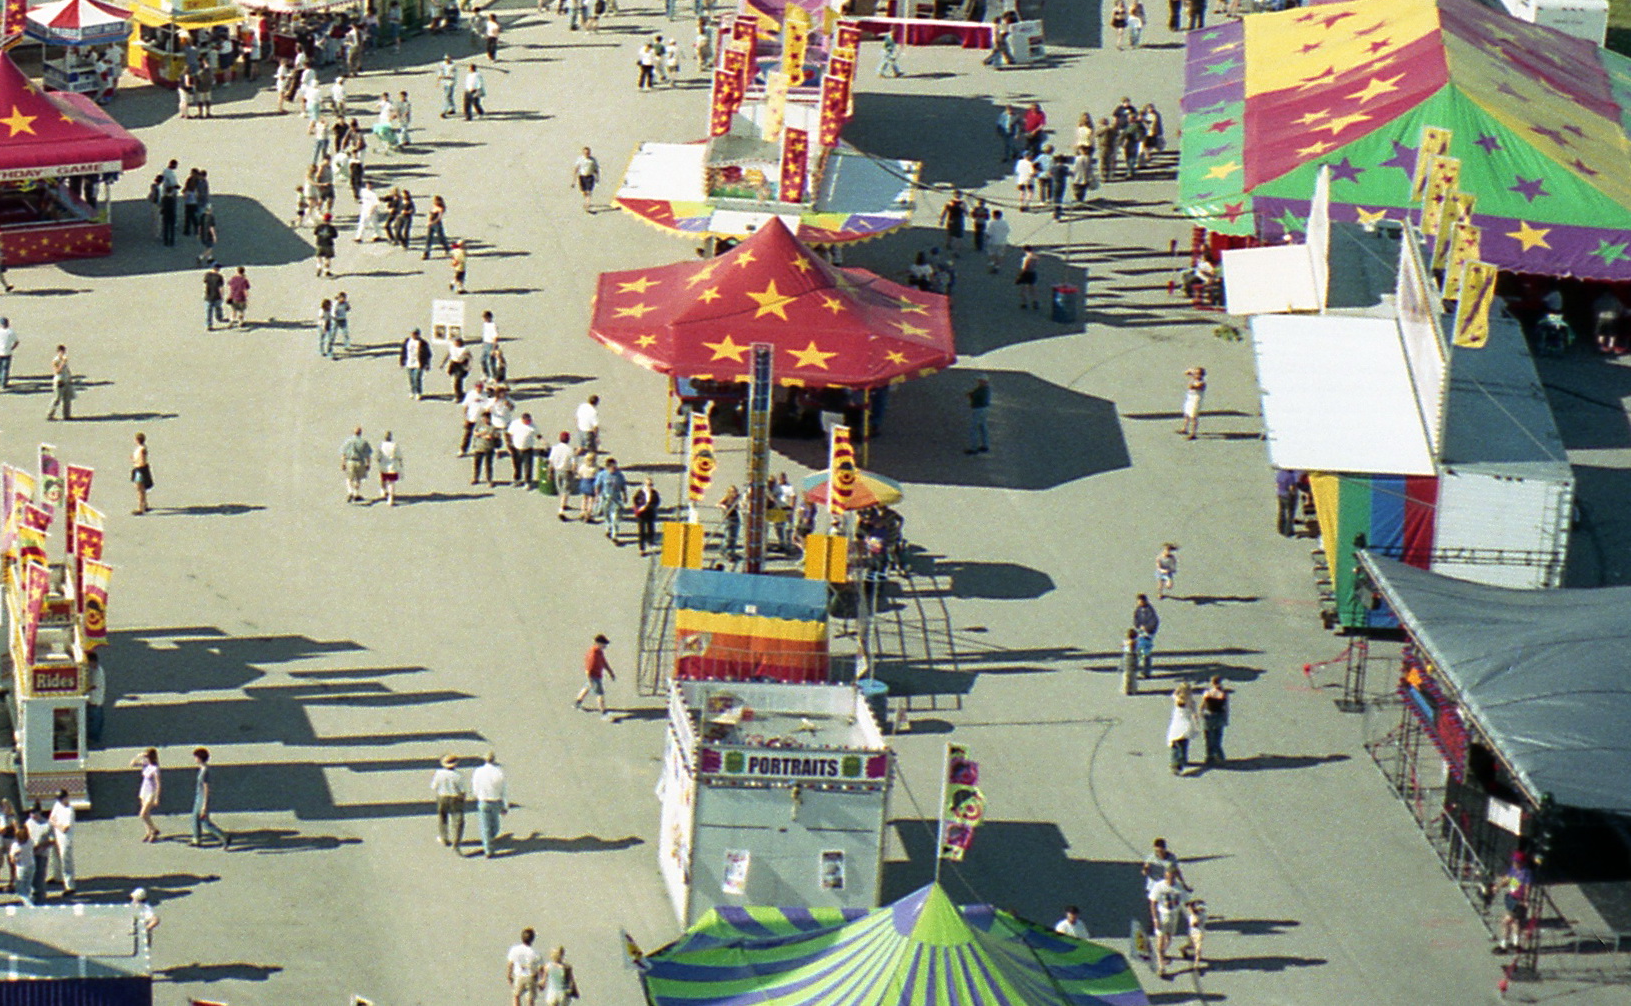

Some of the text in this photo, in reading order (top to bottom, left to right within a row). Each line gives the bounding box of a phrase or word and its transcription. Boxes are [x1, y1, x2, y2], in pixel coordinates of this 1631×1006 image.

[57, 163, 104, 174] GAME
[36, 672, 75, 689] Rides
[748, 756, 839, 777] PORTRAITS
